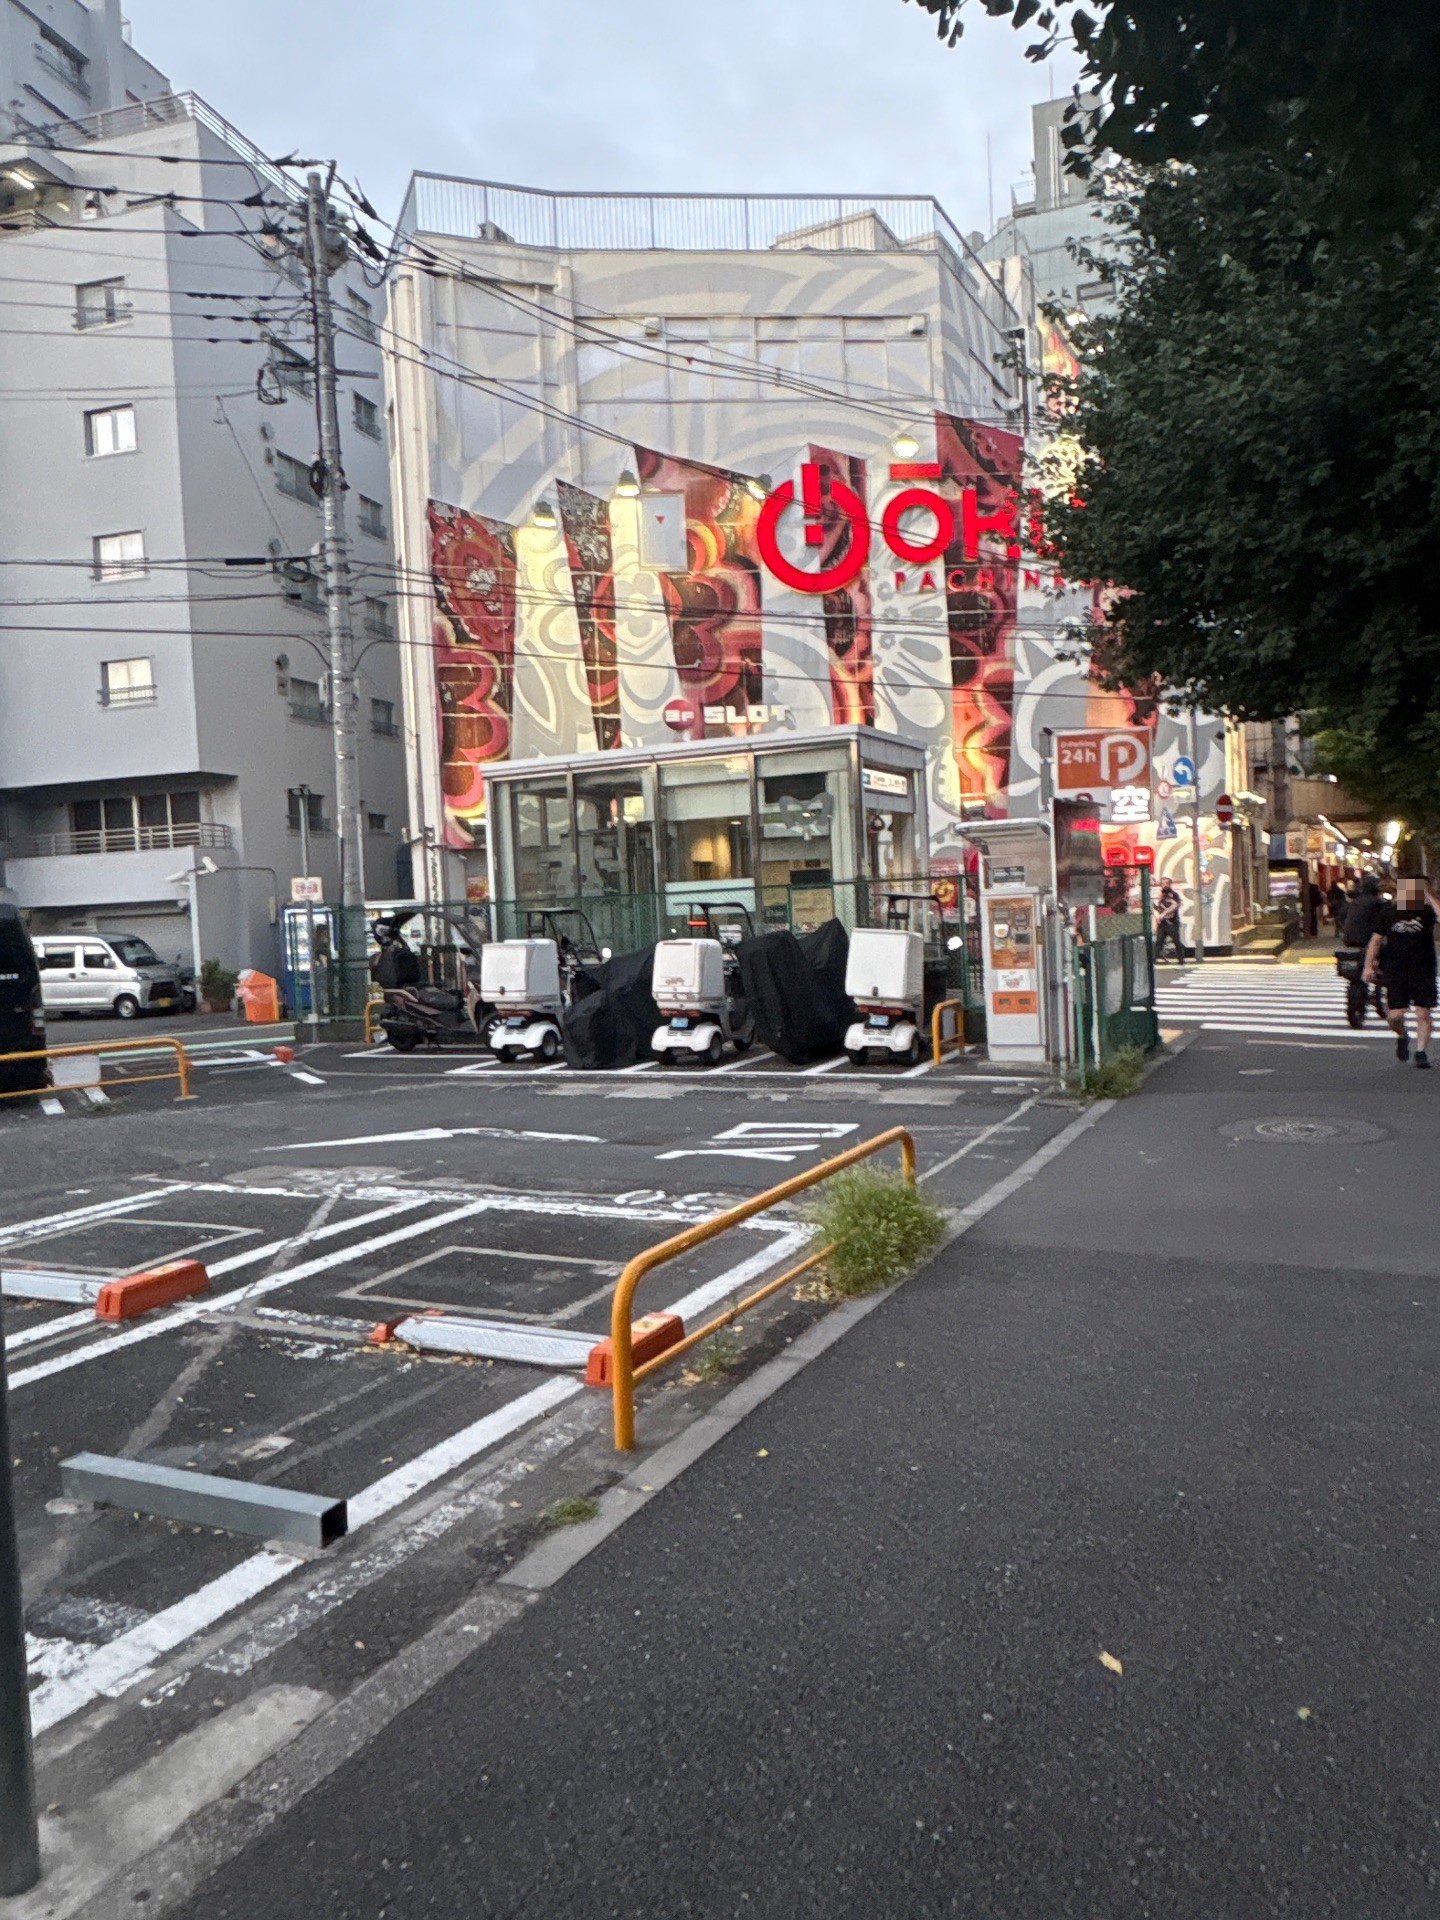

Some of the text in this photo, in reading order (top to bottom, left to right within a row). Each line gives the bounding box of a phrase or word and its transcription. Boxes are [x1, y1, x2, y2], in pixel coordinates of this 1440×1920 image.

[703, 704, 791, 724] SLOT
[1061, 748, 1097, 765] 24h
[1100, 734, 1147, 782] P
[1111, 785, 1151, 822] 空
